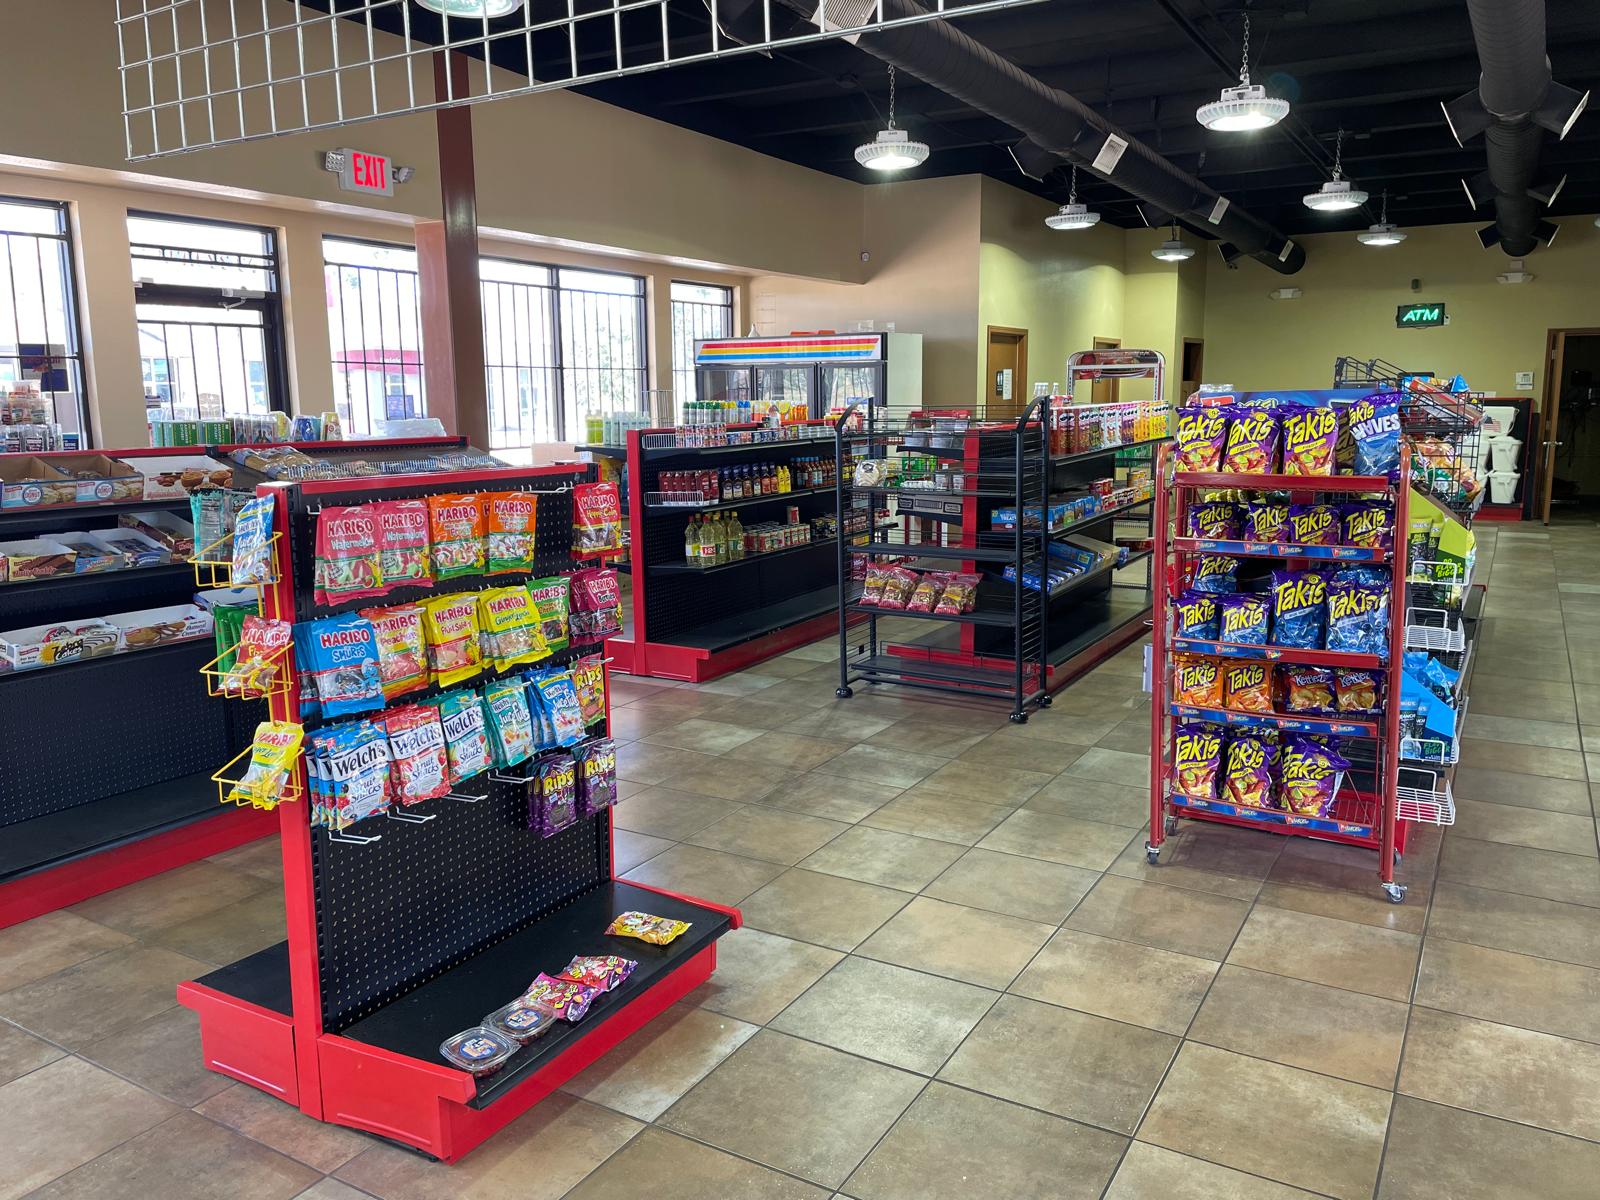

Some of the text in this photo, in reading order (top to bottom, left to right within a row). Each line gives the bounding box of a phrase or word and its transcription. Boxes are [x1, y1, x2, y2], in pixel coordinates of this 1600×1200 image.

[352, 152, 386, 190] EXIT
[1402, 307, 1440, 323] ATM
[1177, 412, 1226, 449] Takis
[1283, 411, 1336, 450] Takis
[437, 505, 477, 521] HARIBO
[494, 500, 533, 515] HARIBO
[580, 493, 617, 511] HARIBO
[327, 518, 375, 537] HARIBO
[381, 512, 424, 529] HARIBO
[1197, 506, 1233, 529] Takis
[1252, 506, 1289, 533] Takis
[1290, 511, 1333, 540] Takis
[1346, 508, 1386, 540] Takis
[1197, 556, 1238, 580] Takis
[1436, 563, 1463, 573] FLAVR
[1437, 567, 1464, 578] BIGGR
[531, 584, 568, 603] HARIBO
[589, 576, 616, 594] HARIBO
[489, 595, 528, 614] HARIBO
[1274, 579, 1327, 617] Takis
[372, 613, 417, 632] HARIBO
[435, 604, 474, 623] HARIBO
[1180, 603, 1216, 631] Takis
[1223, 606, 1263, 635] Takis
[52, 639, 84, 660] Zebra
[320, 628, 371, 648] HARIBO
[331, 645, 366, 662] SMURFS
[1183, 666, 1217, 691] Takis
[1228, 668, 1264, 694] Takis
[445, 709, 483, 739] Welch's
[394, 724, 441, 755] Welch's
[1176, 735, 1221, 767] Takis
[335, 742, 386, 777] Welch's
[1226, 740, 1265, 775] Takis
